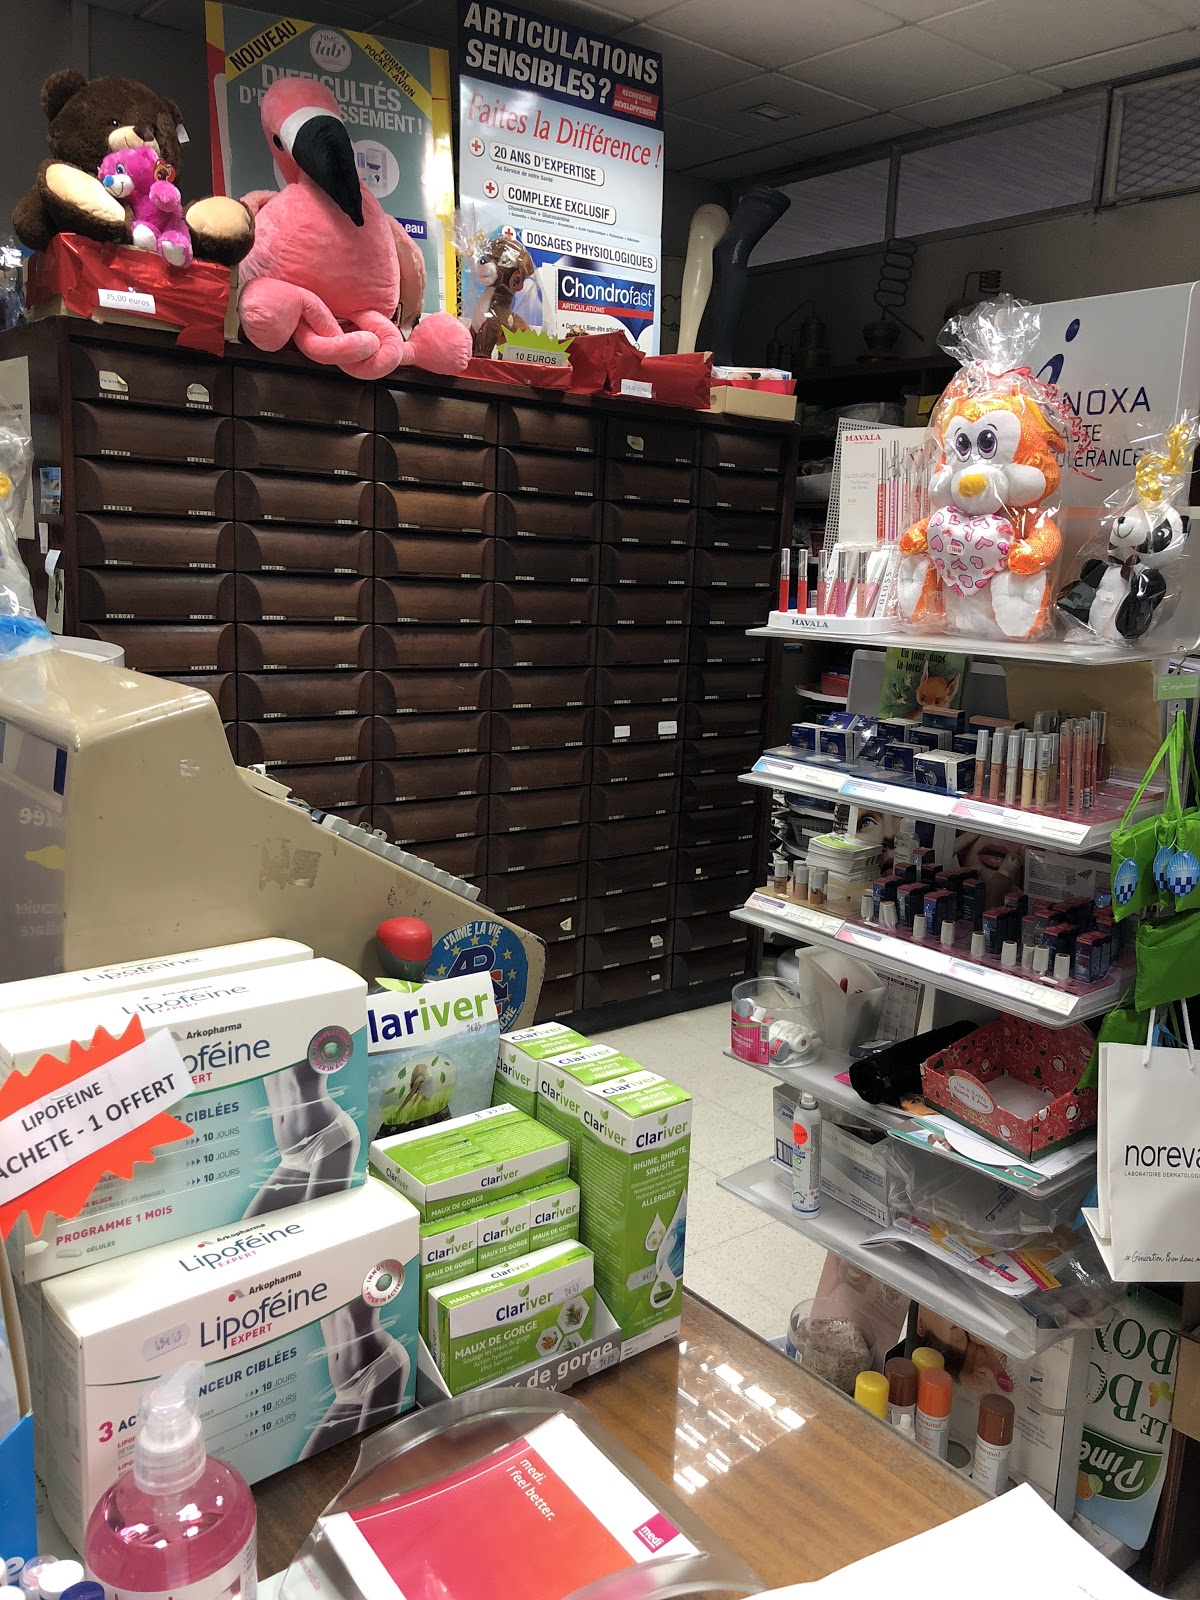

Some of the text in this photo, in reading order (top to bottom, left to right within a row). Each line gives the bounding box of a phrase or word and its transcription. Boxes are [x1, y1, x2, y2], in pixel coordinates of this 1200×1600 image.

[229, 20, 298, 72] NOUVEAU
[320, 34, 340, 45] NMC
[463, 1, 659, 85] ARTICULATIONS
[364, 43, 416, 98] POCKET-AVION
[379, 49, 411, 80] FORMAT
[465, 38, 612, 104] SENSIBLES ?
[622, 88, 652, 103] RECHERCHE
[614, 99, 657, 117] DÉVELOPPEMENT
[467, 91, 662, 168] Faites la Différence !
[494, 145, 597, 182] 20 ANS D'EXPERTISE
[508, 187, 610, 220] COMPLEXE EXCLUSIF
[405, 221, 424, 234] eau
[527, 232, 653, 269] DOSAGES PHYSIOLOGIQUES
[106, 293, 150, 306] 35,00 euros
[561, 275, 652, 307] Chondrofast
[562, 303, 605, 313] ARTICULATIONS
[515, 352, 557, 365] 10 EUROS
[845, 434, 881, 442] MAVALA
[792, 619, 829, 629] MAVALA
[897, 660, 903, 670] la
[911, 650, 945, 664] jour dans
[442, 922, 504, 951] J'AIME LA VIE
[121, 985, 249, 1015] Lipoféine
[367, 990, 489, 1044] lariver
[186, 1022, 242, 1040] Arkopharma
[511, 1026, 562, 1041] Clariver
[558, 1049, 611, 1065] Clariver
[603, 1075, 656, 1095] Clariver
[88, 1113, 103, 1133] 1
[106, 1073, 178, 1122] OFFERT
[541, 1080, 581, 1114] Clariver
[185, 1102, 240, 1121] CIBLÉES
[203, 1127, 240, 1142] 10 JOURS
[583, 1111, 627, 1147] Clariver
[635, 1120, 688, 1148] Clariver
[204, 1148, 240, 1163] 10 JOURS
[633, 1146, 688, 1171] RHUME, RHINITE,
[204, 1167, 241, 1183] 10 JOURS
[480, 1169, 519, 1187] Clariver
[645, 1160, 675, 1176] SINUSITE
[431, 1206, 451, 1217] MAUX
[452, 1202, 461, 1210] DE
[461, 1195, 484, 1208] GORGE
[641, 1188, 676, 1208] ALLERGIES
[56, 1205, 173, 1245] PROGRAMME 1 MOIS
[535, 1204, 577, 1224] Clariver
[216, 1222, 265, 1243] Arkopharma
[483, 1221, 527, 1243] Clariver
[532, 1221, 578, 1241] MAUX DE GORGE
[86, 1240, 116, 1253] GÉLULES
[179, 1221, 305, 1273] Lipoféine
[427, 1240, 473, 1262] Clariver
[480, 1238, 528, 1260] MAUX DE GORGE
[217, 1251, 258, 1268] EXPERT
[425, 1257, 475, 1279] MAUX DE GORGE
[491, 1261, 530, 1279] Clariver
[249, 1270, 302, 1296] Arkopharma
[449, 1294, 470, 1304] MAUX
[480, 1282, 505, 1293] GORGE
[200, 1282, 328, 1349] Lipoféine
[496, 1291, 553, 1321] Clariver
[231, 1322, 272, 1347] EXPERT
[455, 1341, 486, 1360] MAUX
[488, 1334, 501, 1346] DE
[503, 1320, 538, 1340] GORGE
[246, 1347, 298, 1377] CIBLÉES
[557, 1341, 613, 1380] gorge
[262, 1371, 297, 1392] 10 JOURS
[262, 1392, 297, 1412] 10 JOURS
[99, 1421, 113, 1443] 3
[261, 1411, 297, 1433] 10 JOURS
[1140, 1412, 1169, 1445] LE
[520, 1458, 547, 1485] medi.
[510, 1469, 532, 1490] feel
[525, 1486, 556, 1521] better.
[640, 1525, 664, 1547] medi
